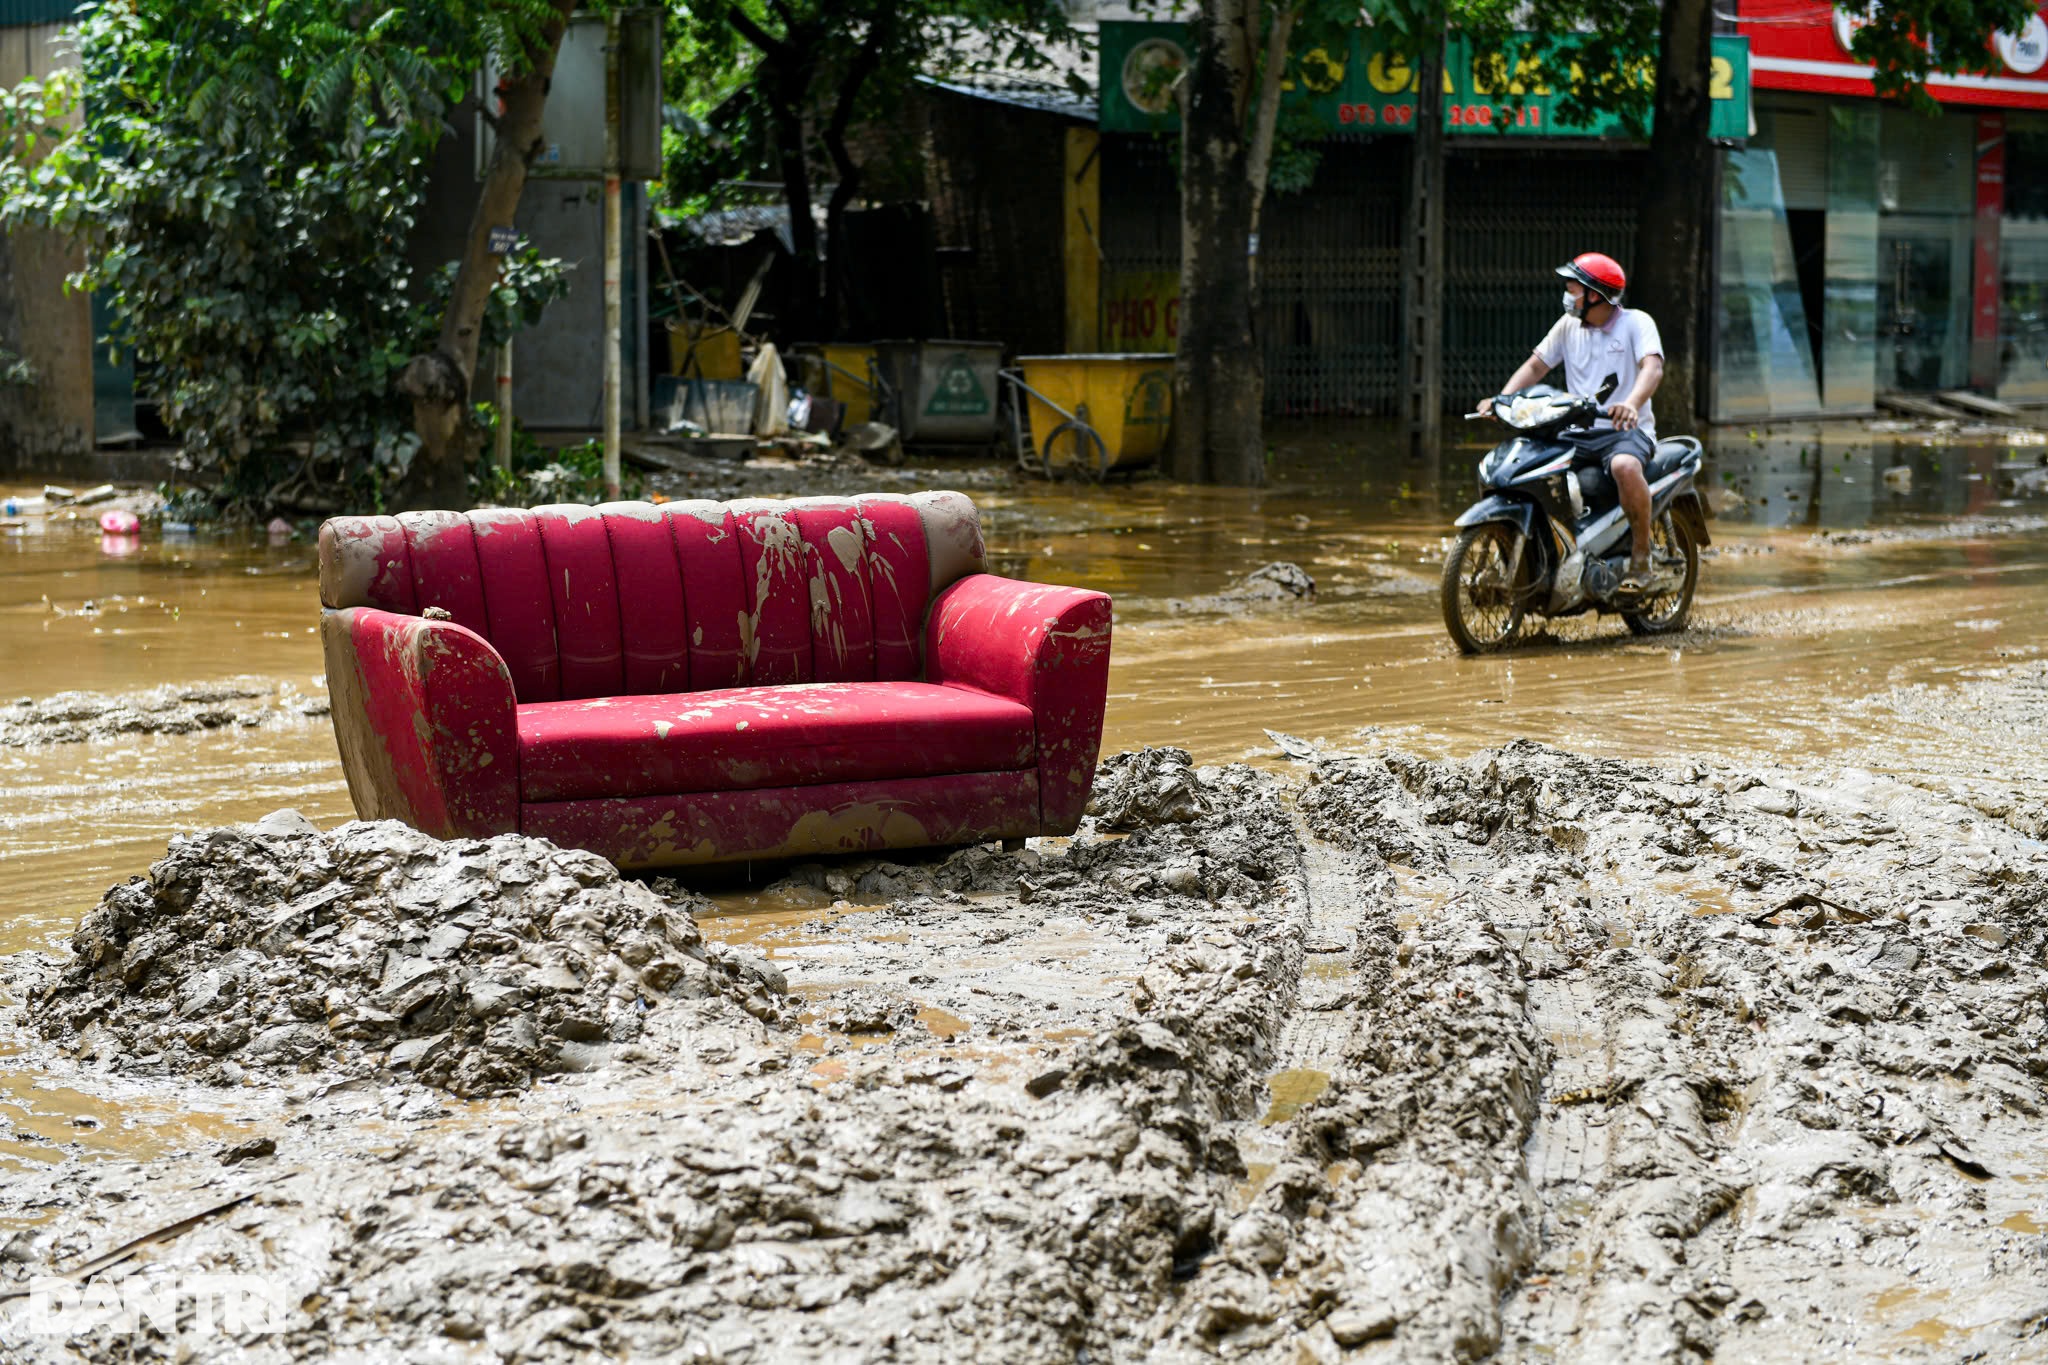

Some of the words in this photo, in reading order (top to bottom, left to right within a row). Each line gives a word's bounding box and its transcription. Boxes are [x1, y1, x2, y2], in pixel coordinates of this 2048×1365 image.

[1709, 56, 1734, 99] 2
[1382, 103, 1419, 125] 09
[1448, 104, 1492, 126] 260
